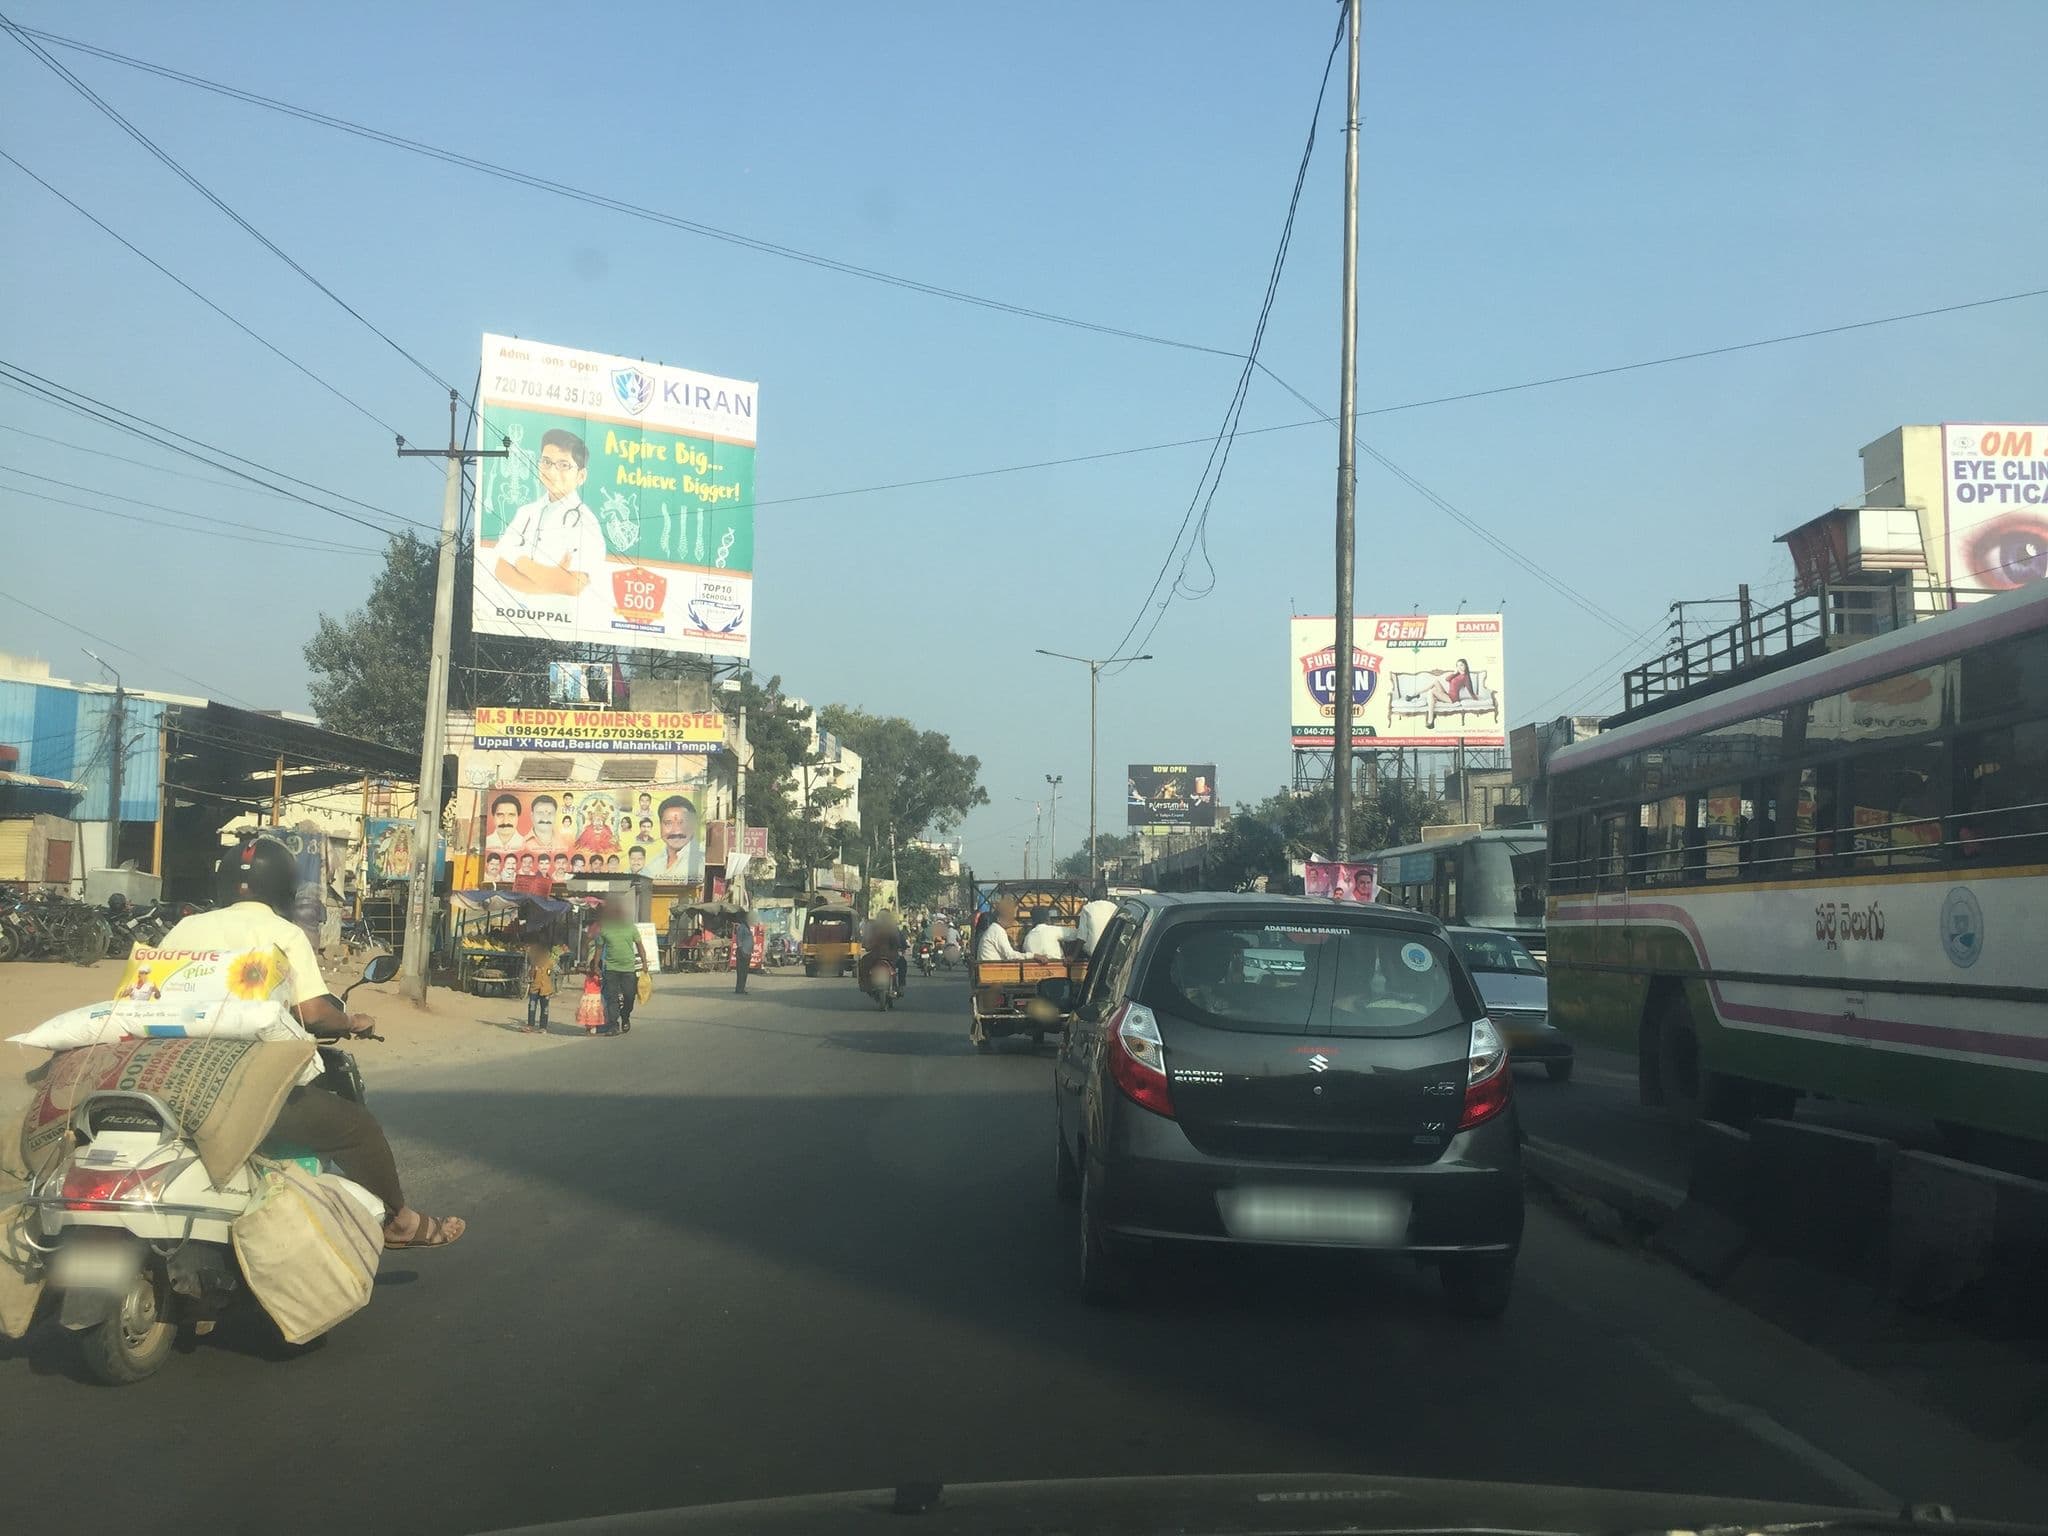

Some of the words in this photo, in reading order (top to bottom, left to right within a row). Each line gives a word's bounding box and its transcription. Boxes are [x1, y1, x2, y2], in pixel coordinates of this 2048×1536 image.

[546, 384, 561, 400] 44
[564, 387, 579, 403] 35
[663, 380, 752, 417] KIRAN
[604, 430, 668, 464] Aspire
[675, 441, 724, 475] Big...
[1980, 431, 2033, 457] OM
[1954, 460, 1997, 480] EYE
[616, 464, 677, 491] Achieve
[682, 475, 740, 503] Bigger!
[624, 580, 656, 595] TOP
[623, 593, 655, 611] 500
[701, 592, 732, 602] SCHOOLS
[496, 607, 572, 624] BODUPPAL
[1377, 622, 1402, 640] 36
[1400, 626, 1425, 639] EMI
[1315, 670, 1370, 691] LON
[477, 709, 507, 724] M.S
[512, 710, 568, 726] REDDY
[574, 712, 652, 729] WOMEN'S
[657, 715, 722, 729] HOSTEL
[478, 736, 513, 749] Uppal
[612, 740, 672, 751] Mahankali
[675, 742, 721, 753] Temple.
[1169, 766, 1188, 774] OPEN
[1264, 924, 1303, 934] ADARSHA
[1318, 927, 1351, 935] MARUTI
